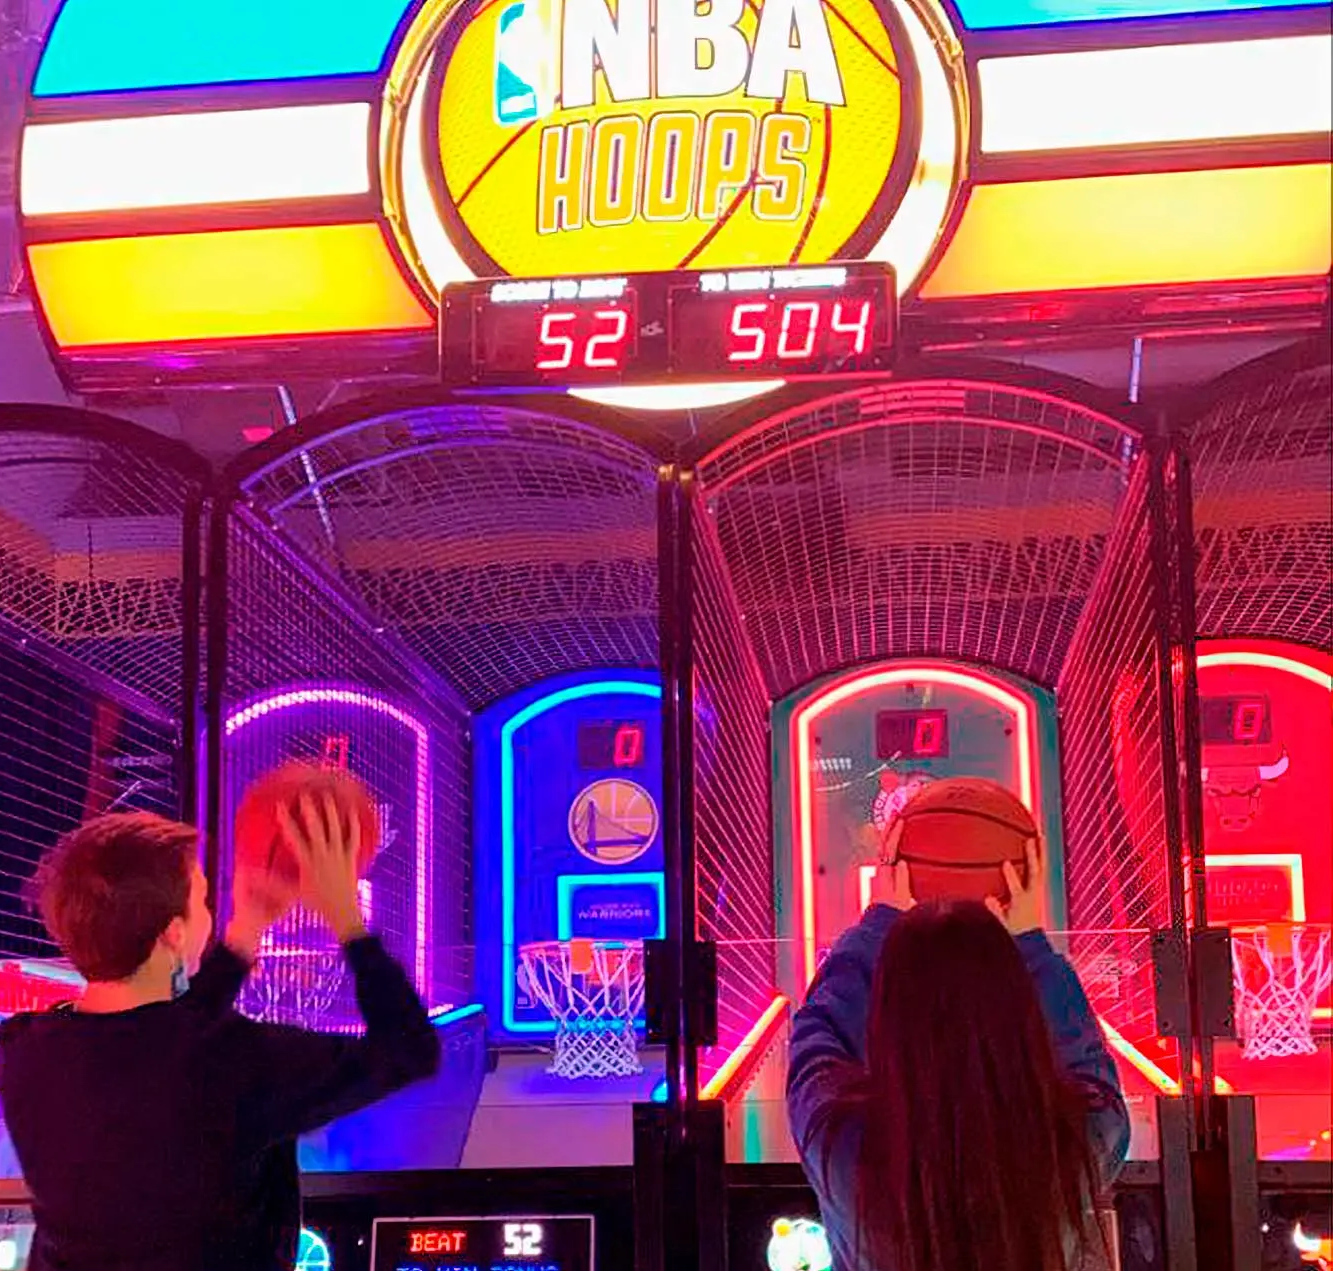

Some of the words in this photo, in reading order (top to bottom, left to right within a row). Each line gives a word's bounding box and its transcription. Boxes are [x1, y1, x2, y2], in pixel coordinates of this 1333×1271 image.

[560, 0, 847, 110] NBA
[537, 111, 811, 235] HOOPS
[537, 311, 627, 369] 52
[729, 301, 870, 361] 504
[913, 717, 943, 753] 0
[1235, 704, 1262, 739] 0
[614, 726, 642, 765] 0
[411, 1232, 466, 1252] BEAT
[504, 1223, 543, 1256] 52
